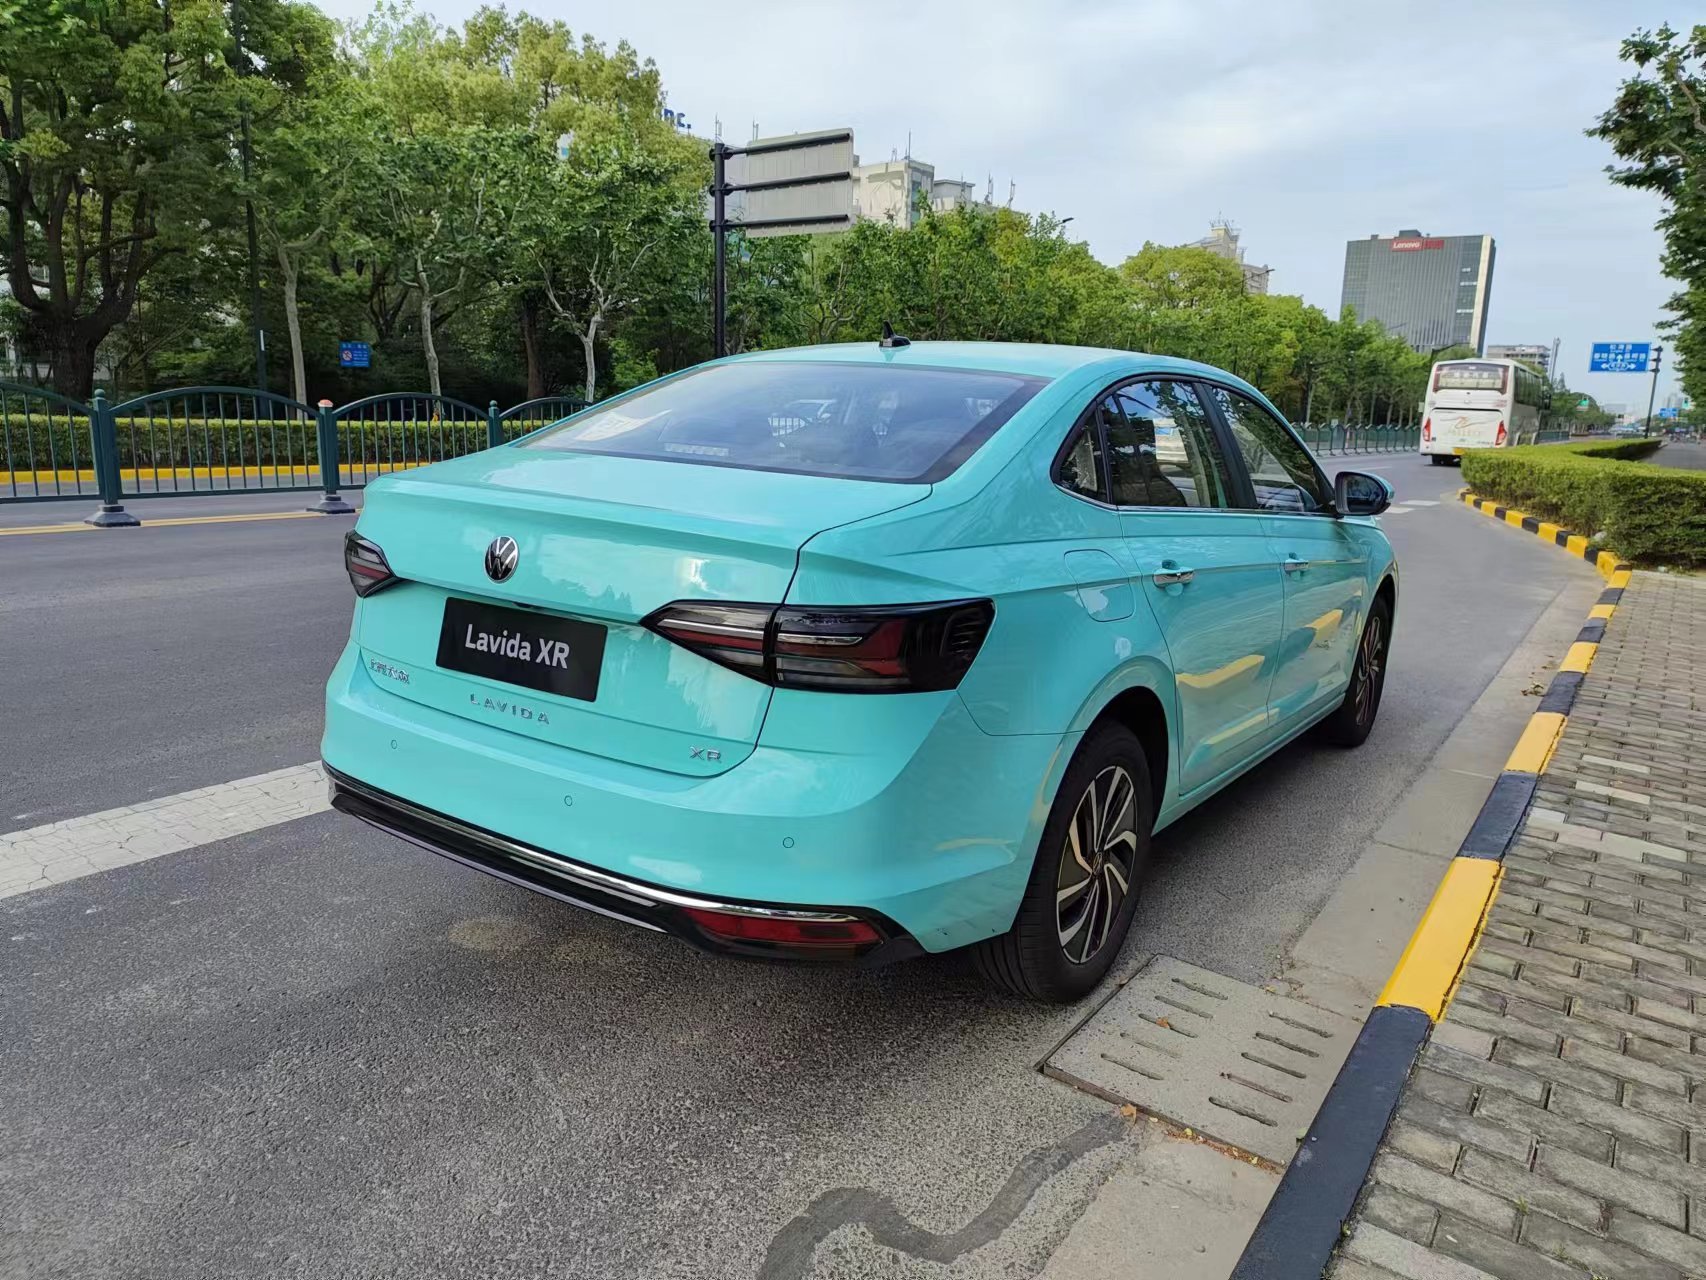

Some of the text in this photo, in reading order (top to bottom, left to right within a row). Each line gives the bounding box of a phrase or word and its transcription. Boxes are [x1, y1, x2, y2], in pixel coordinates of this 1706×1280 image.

[1393, 241, 1421, 249] Lenovo
[464, 623, 570, 669] Lavida XR
[470, 693, 550, 725] LAVIDA
[690, 746, 722, 763] XR
